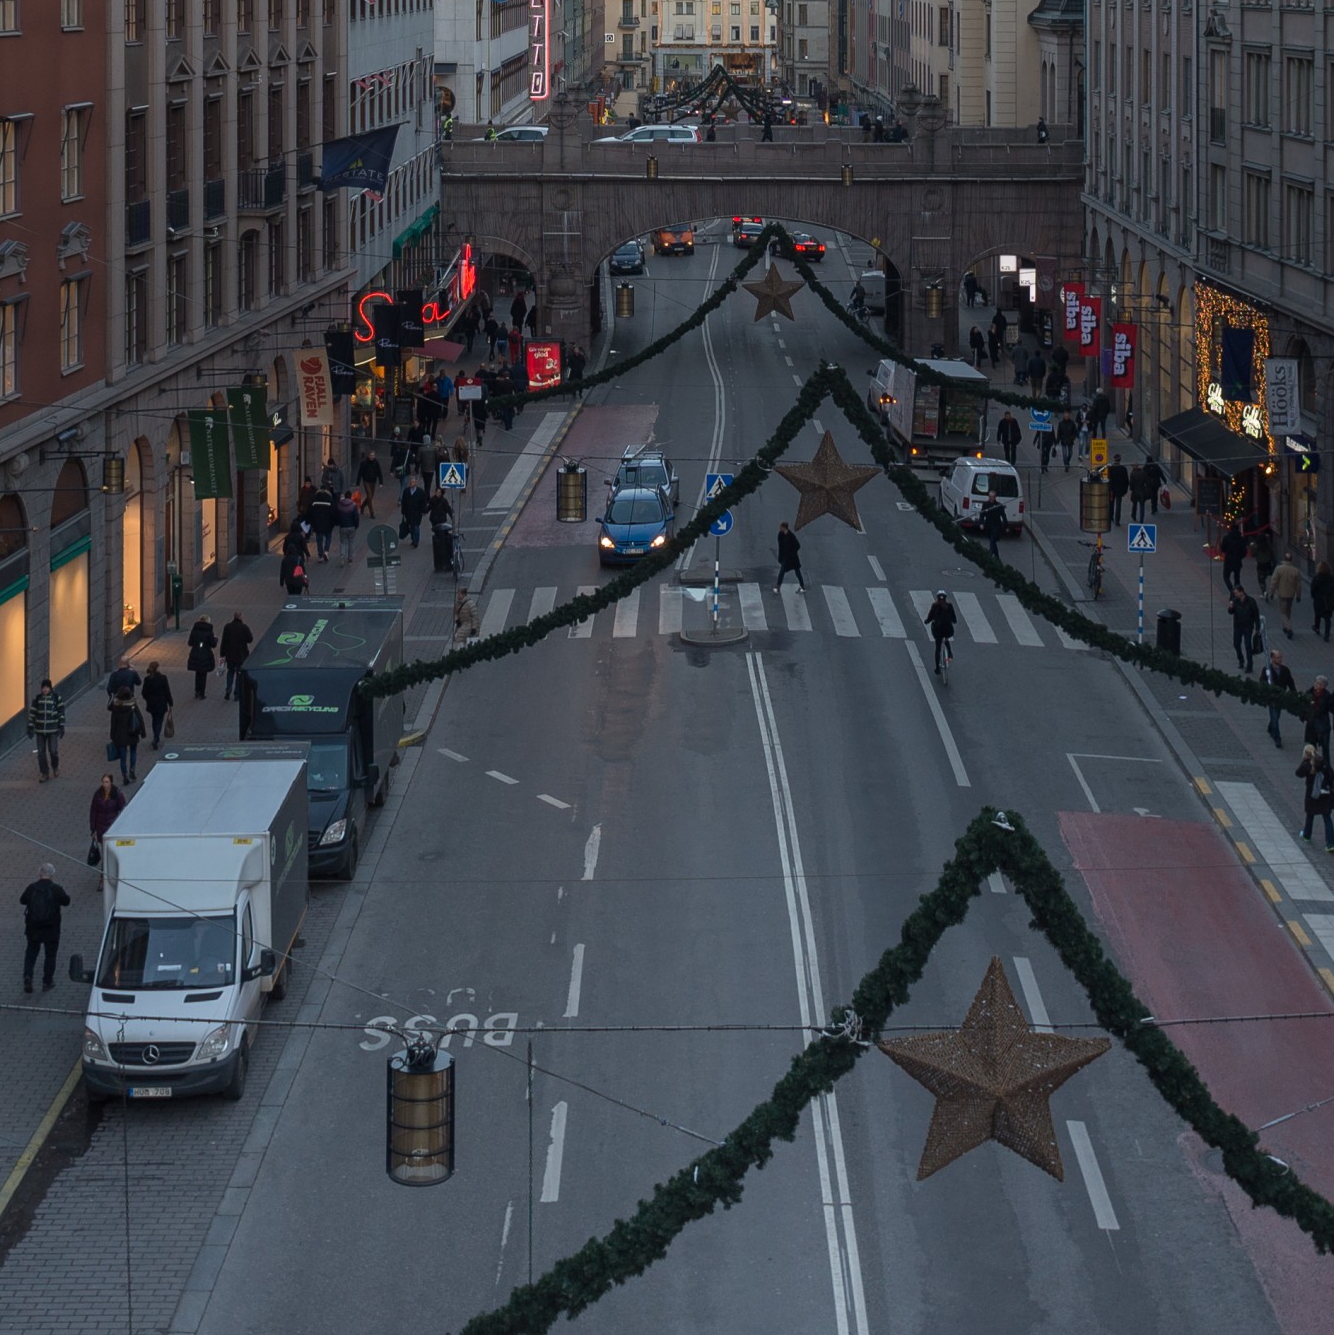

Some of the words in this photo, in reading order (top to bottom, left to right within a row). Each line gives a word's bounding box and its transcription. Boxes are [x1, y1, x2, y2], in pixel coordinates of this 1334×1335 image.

[1065, 291, 1079, 330] siba
[1080, 305, 1097, 346] siba
[1113, 332, 1132, 376] siba
[1270, 365, 1288, 428] Hööks
[206, 429, 218, 494] NATURKOMPANIET
[359, 1012, 519, 1052] BUSS
